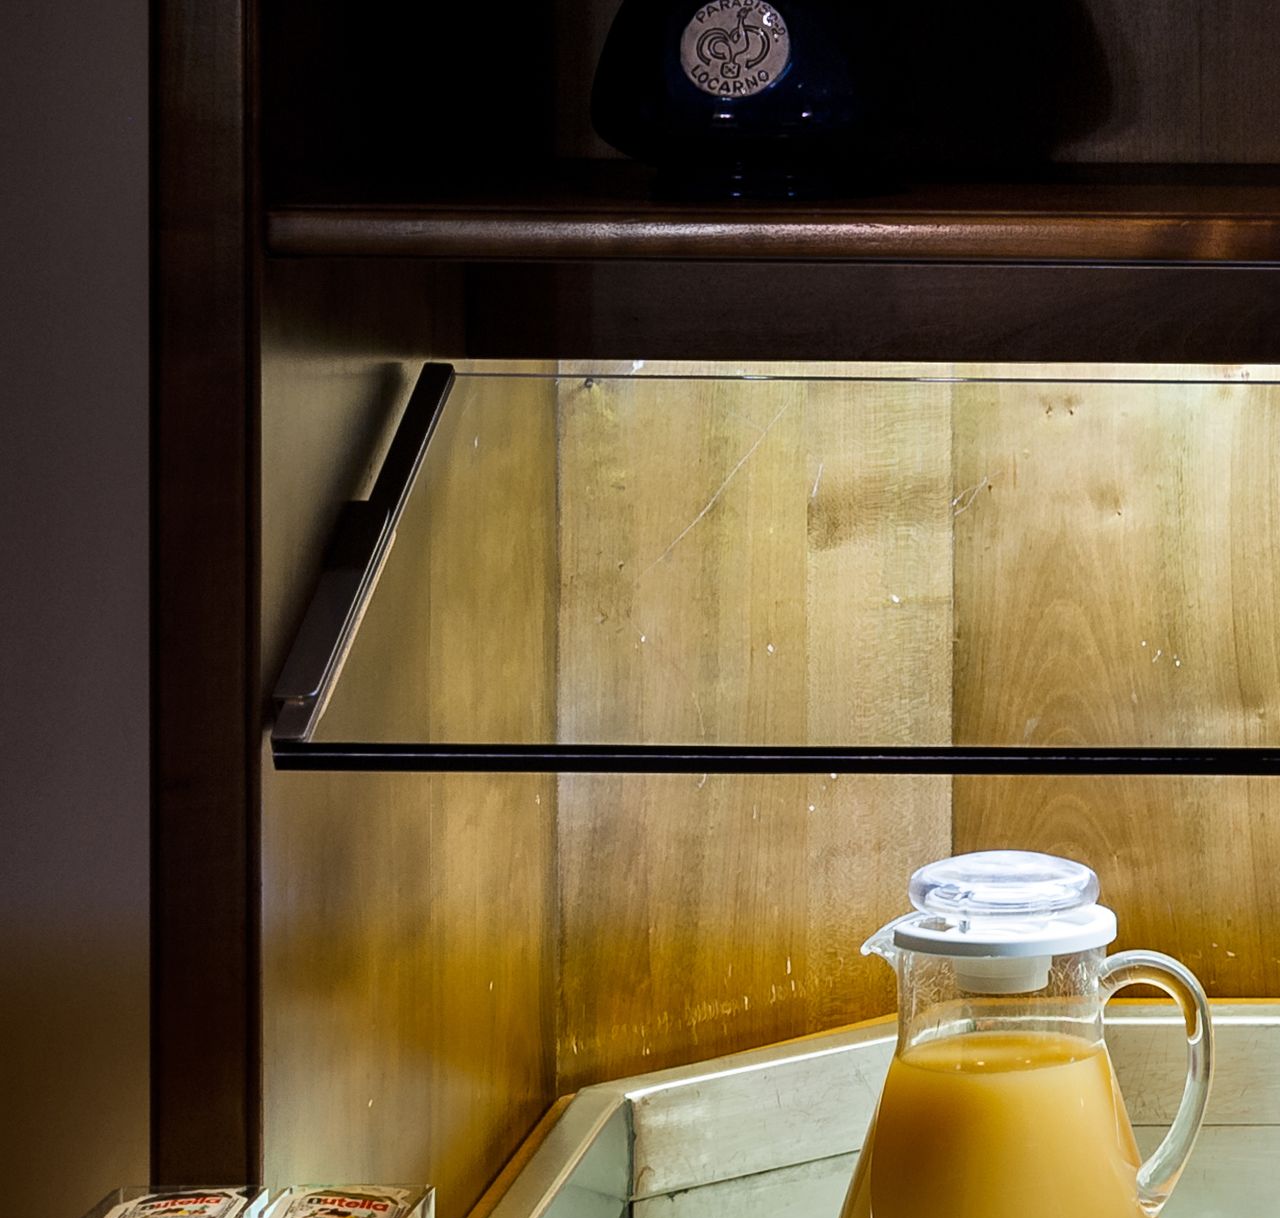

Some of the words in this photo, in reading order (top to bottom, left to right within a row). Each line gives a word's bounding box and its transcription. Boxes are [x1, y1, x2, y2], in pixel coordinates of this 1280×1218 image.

[691, 64, 770, 93] LOCARNO
[140, 1196, 223, 1211] nutella
[307, 1197, 390, 1212] nutella
